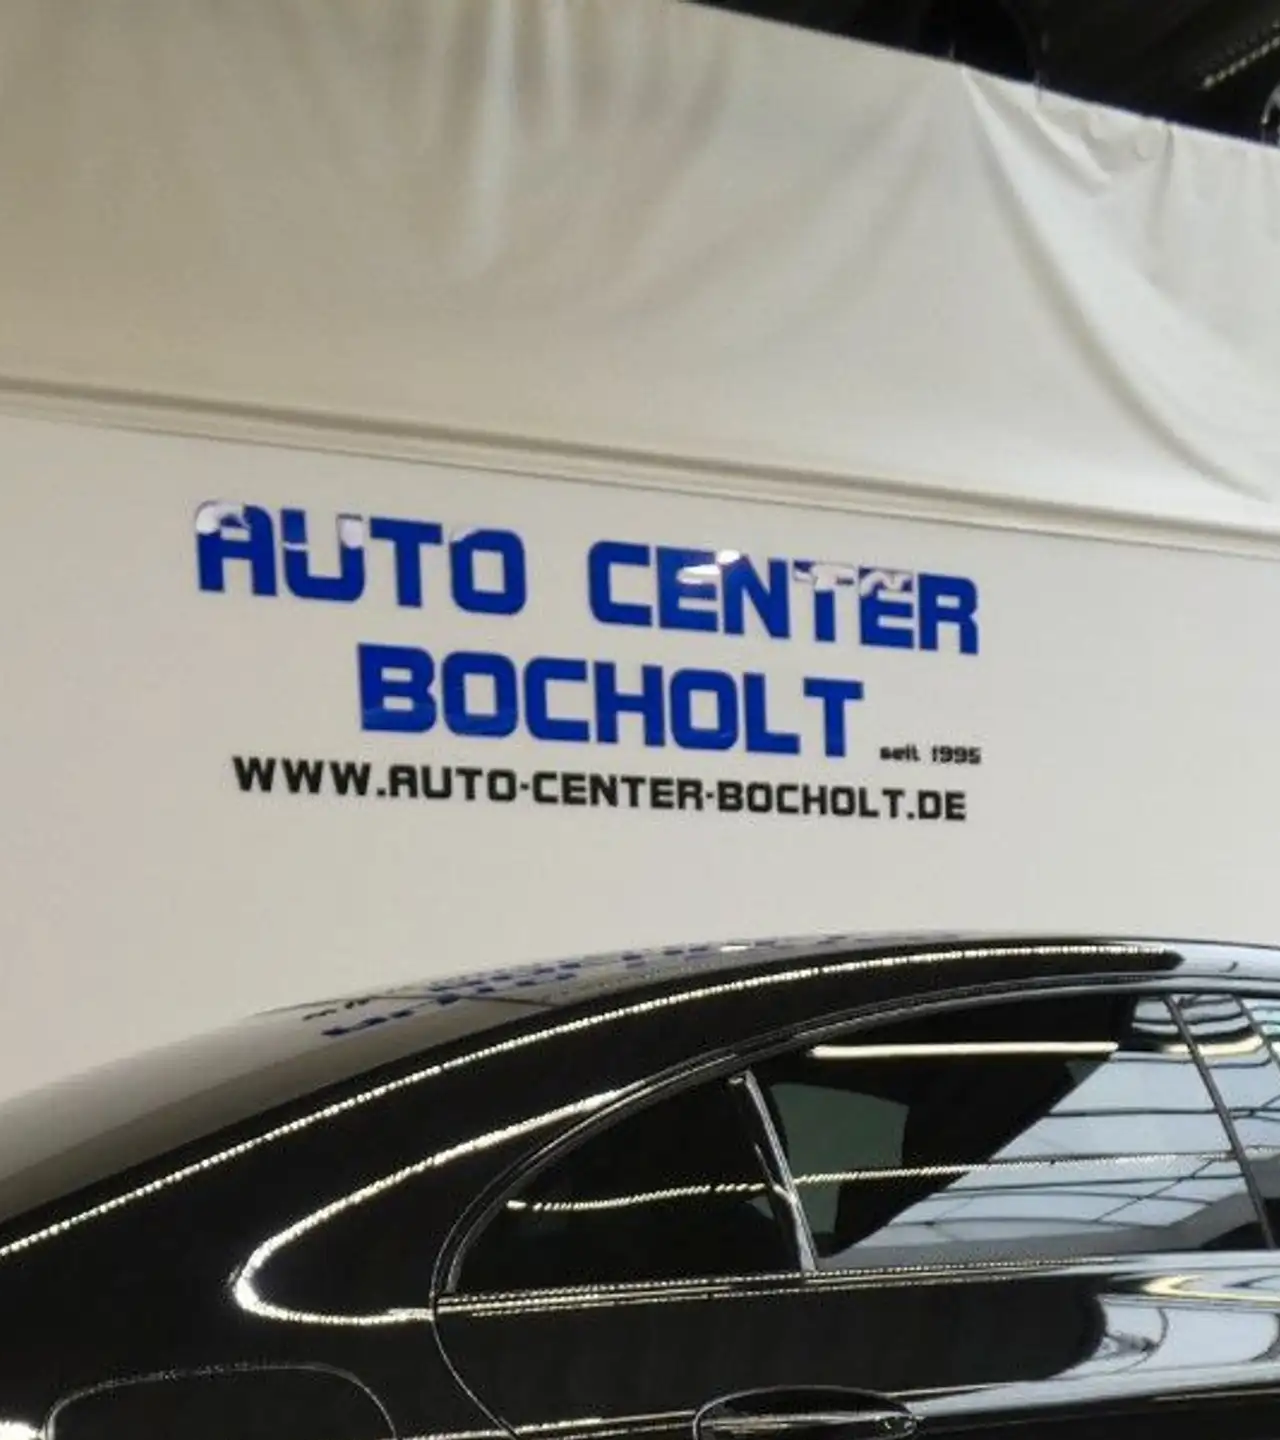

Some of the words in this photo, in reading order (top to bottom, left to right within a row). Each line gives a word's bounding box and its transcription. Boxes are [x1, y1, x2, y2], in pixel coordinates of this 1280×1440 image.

[195, 501, 527, 616] AUTO
[587, 540, 979, 655] CENTER
[357, 643, 864, 758] BOCHOLT
[232, 756, 967, 821] WWW.AUTO-CENTER-BOCHOLT.DE
[880, 744, 920, 762] seit
[931, 745, 981, 765] 1995
